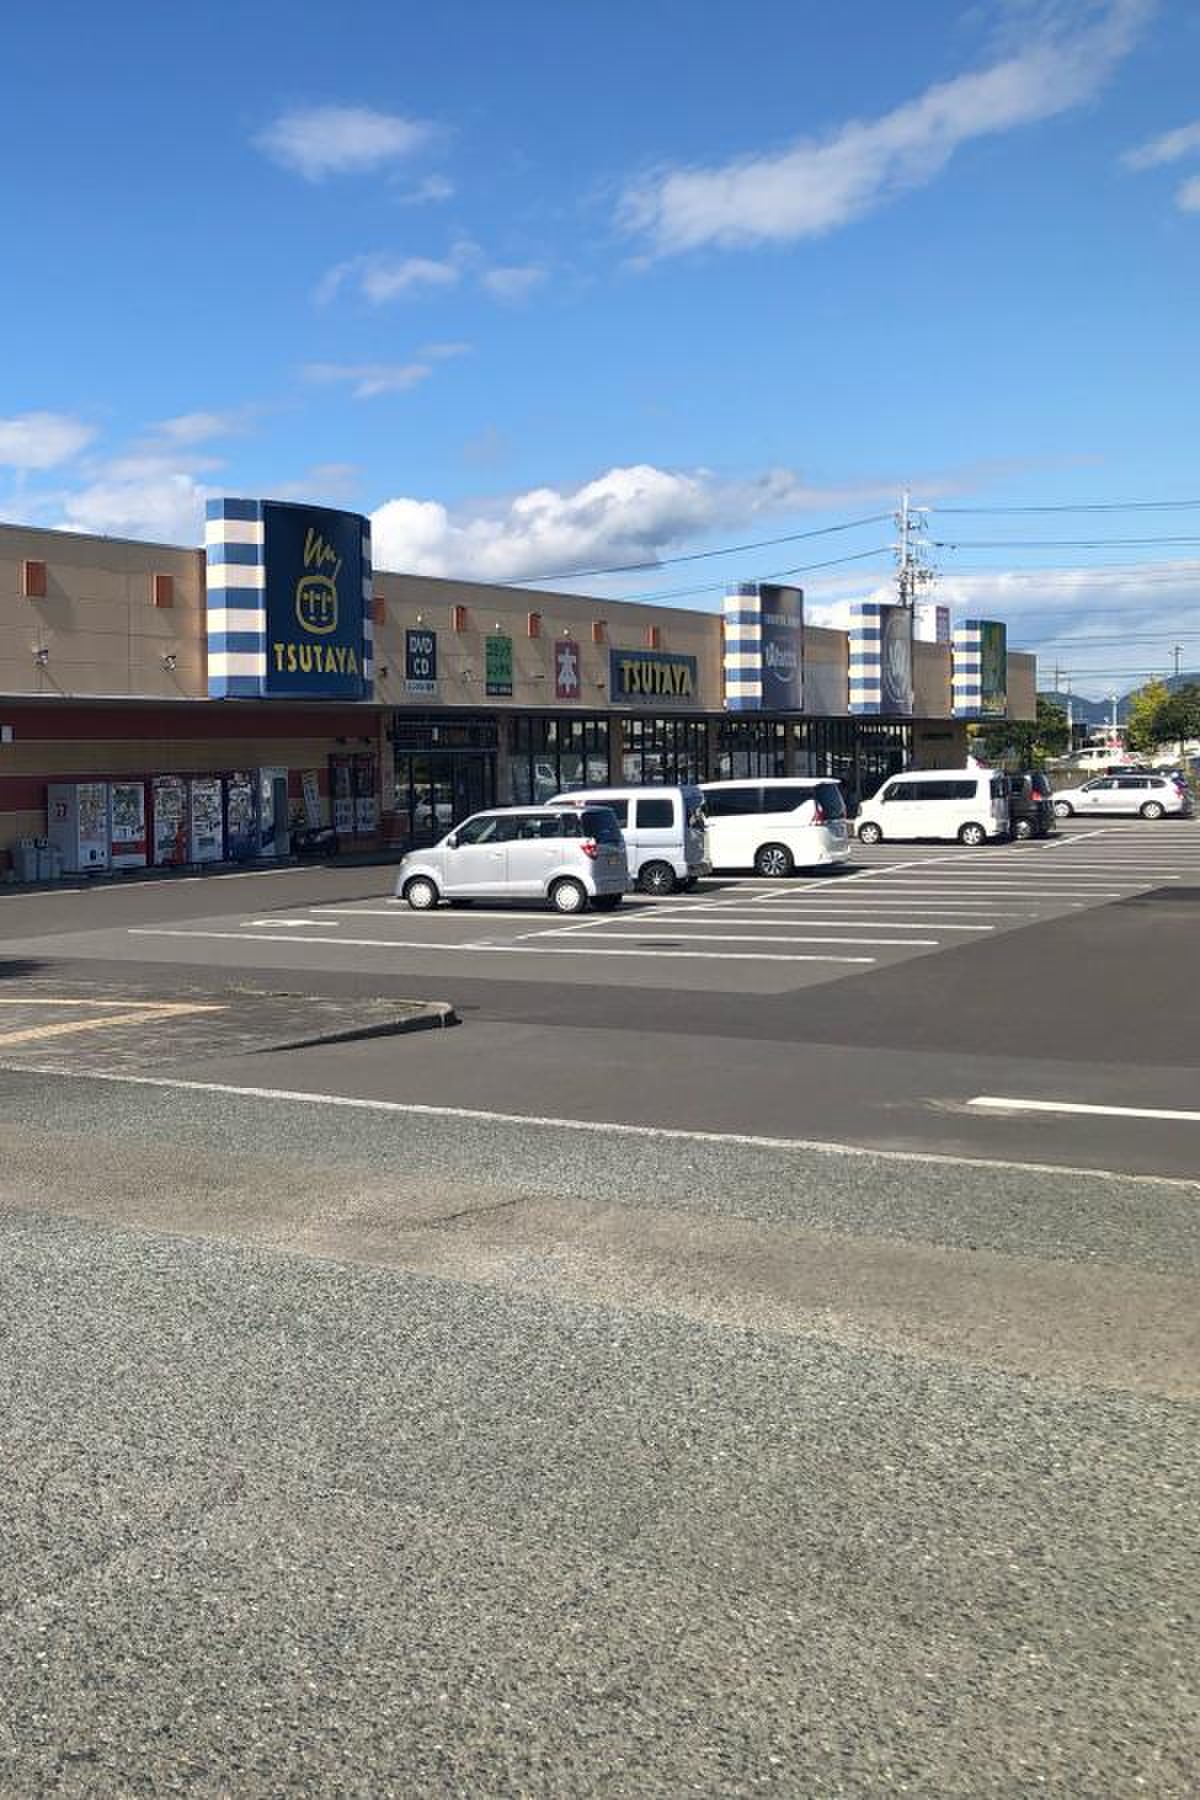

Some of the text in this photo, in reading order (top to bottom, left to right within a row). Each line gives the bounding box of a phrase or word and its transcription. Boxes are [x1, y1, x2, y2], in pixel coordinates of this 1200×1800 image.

[273, 643, 358, 674] TSUTAYA
[409, 636, 432, 654] DVD
[620, 659, 691, 694] TSUTAYA
